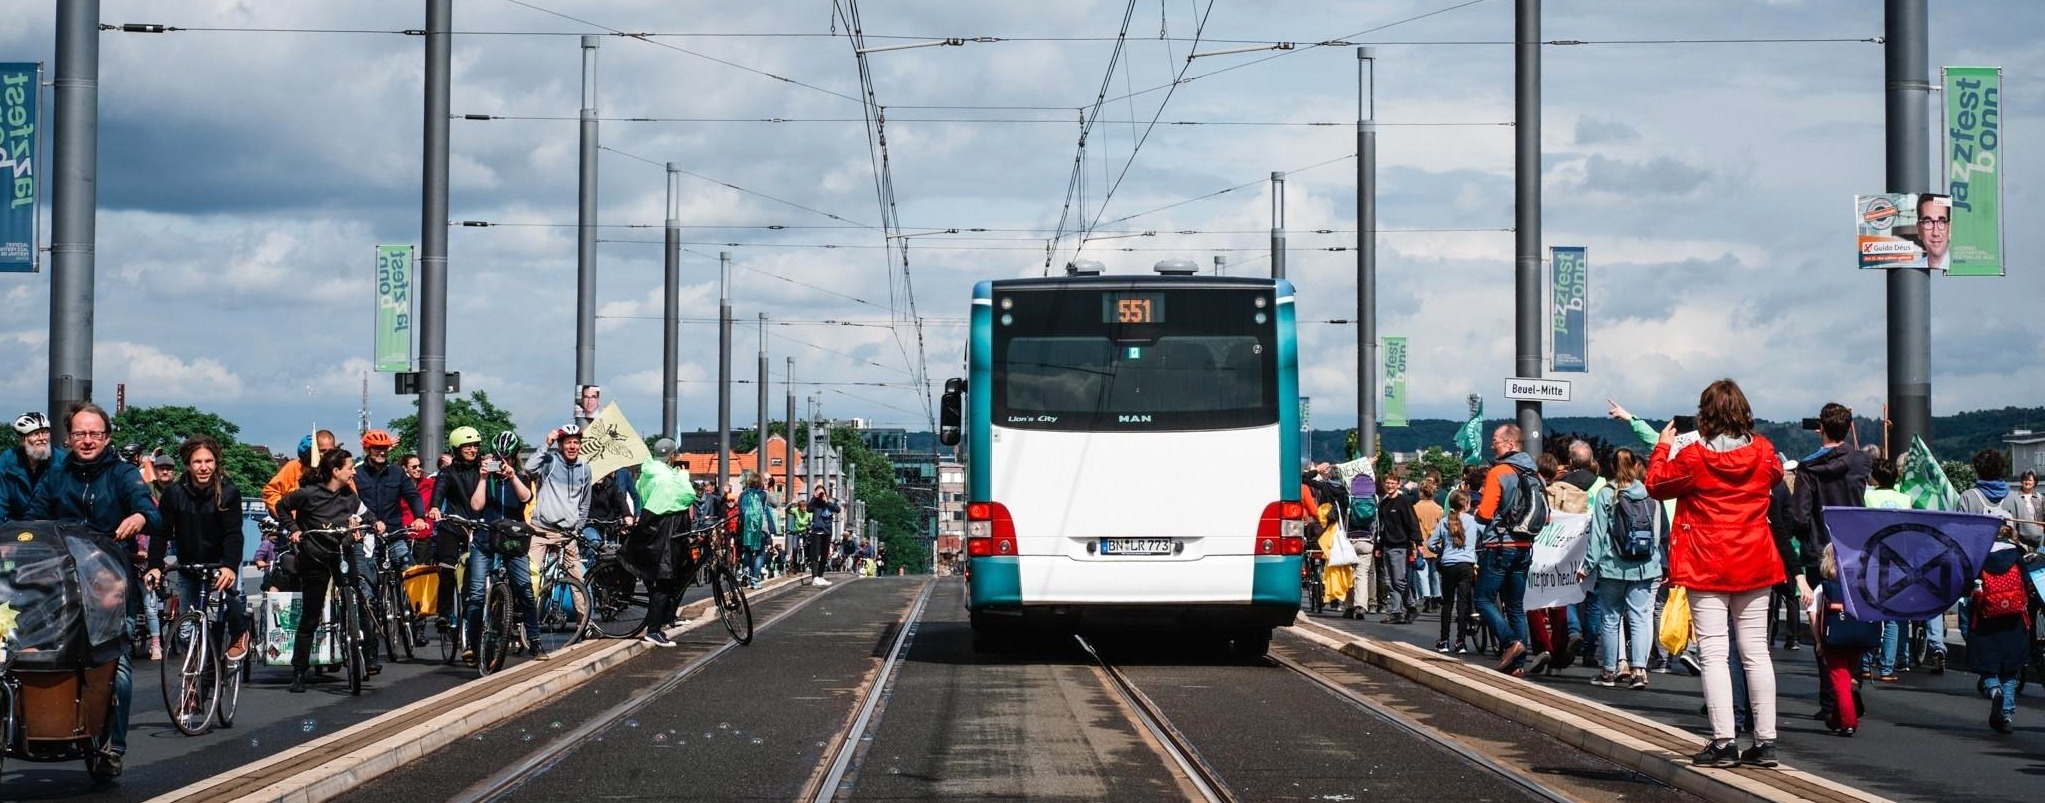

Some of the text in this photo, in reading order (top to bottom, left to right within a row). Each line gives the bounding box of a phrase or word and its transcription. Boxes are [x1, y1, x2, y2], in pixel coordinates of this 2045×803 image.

[1950, 77, 1982, 213] jazzfest
[1966, 87, 1998, 174] bonn
[1873, 244, 1893, 252] Guido
[1553, 252, 1575, 336] jazzfest
[1567, 258, 1585, 312] bonn
[1118, 299, 1151, 323] 551
[1384, 341, 1400, 399] jazzfest
[1394, 345, 1407, 383] bonn
[1511, 383, 1564, 397] Beuel-Mitte
[1037, 415, 1058, 423] City
[1108, 540, 1169, 551] BN LR 773
